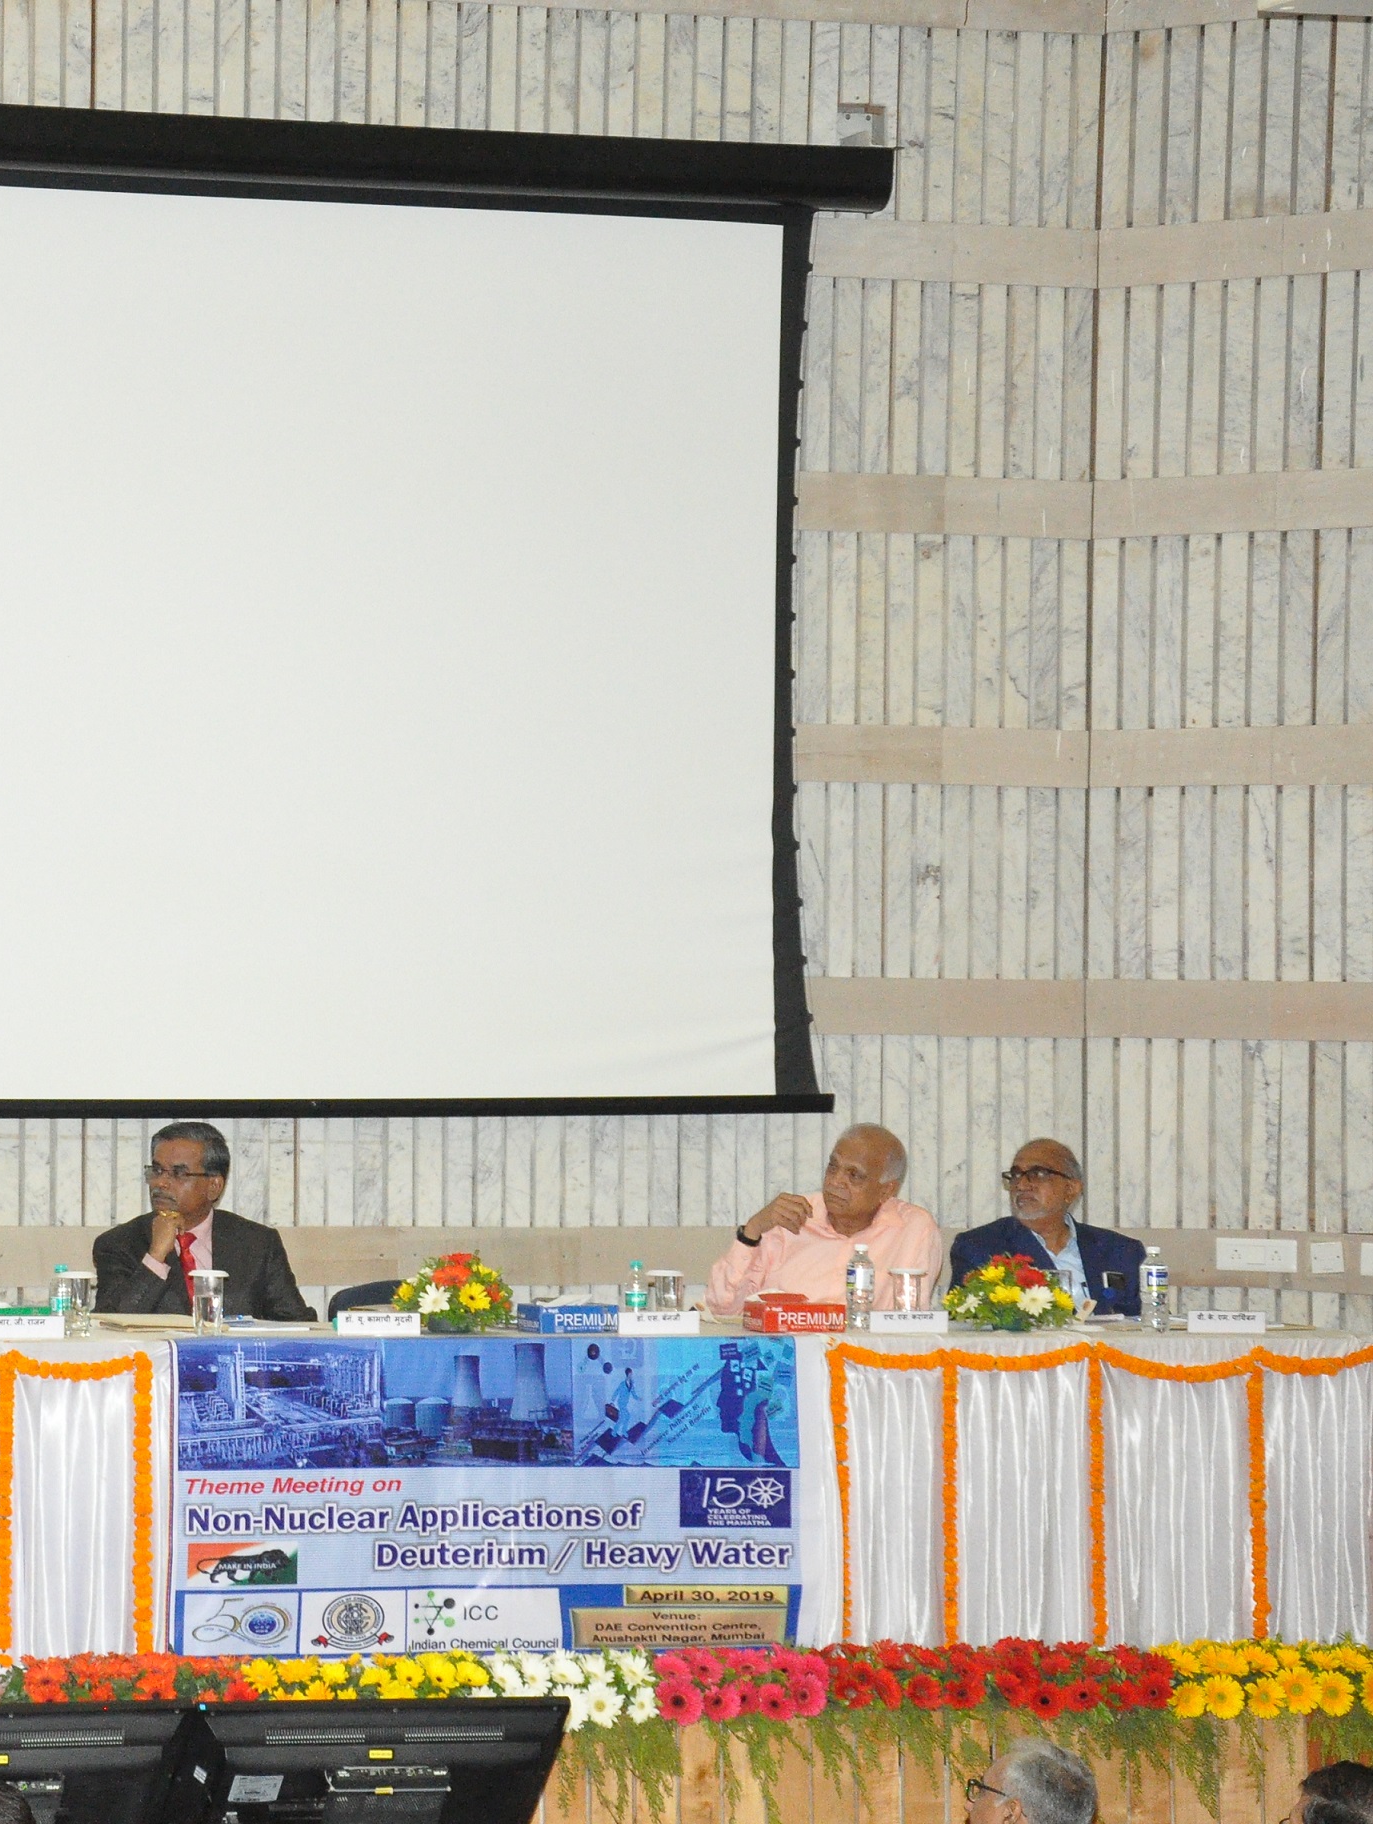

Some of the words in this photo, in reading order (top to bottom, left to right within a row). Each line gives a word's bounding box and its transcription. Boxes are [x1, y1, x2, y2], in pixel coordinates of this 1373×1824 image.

[555, 1313, 618, 1326] PREMIUM
[778, 1312, 844, 1325] PREMIUM
[185, 1478, 265, 1495] Theme
[272, 1476, 365, 1496] Meeting
[372, 1479, 402, 1492] on
[188, 1506, 390, 1532] Non-Nuclear
[399, 1503, 601, 1533] Applications
[609, 1502, 643, 1528] of
[377, 1541, 546, 1568] Deuterium
[552, 1541, 576, 1572] /
[585, 1541, 681, 1571] Heavy
[688, 1541, 791, 1565] Water
[242, 1562, 253, 1570] IN
[253, 1562, 277, 1570] INDIA
[640, 1590, 684, 1602] April
[691, 1590, 721, 1603] 30,
[727, 1590, 774, 1602] 2019
[463, 1605, 499, 1621] ICC
[652, 1611, 702, 1620] Venue:
[595, 1623, 623, 1632] DAE
[627, 1622, 707, 1632] Convention
[712, 1622, 762, 1632] Centre,
[411, 1639, 446, 1650] Indian
[450, 1638, 508, 1649] Chemical
[512, 1637, 559, 1649] Council
[592, 1633, 657, 1643] Anushakti
[662, 1633, 707, 1644] Nagar,
[711, 1632, 766, 1642] Mumbai
